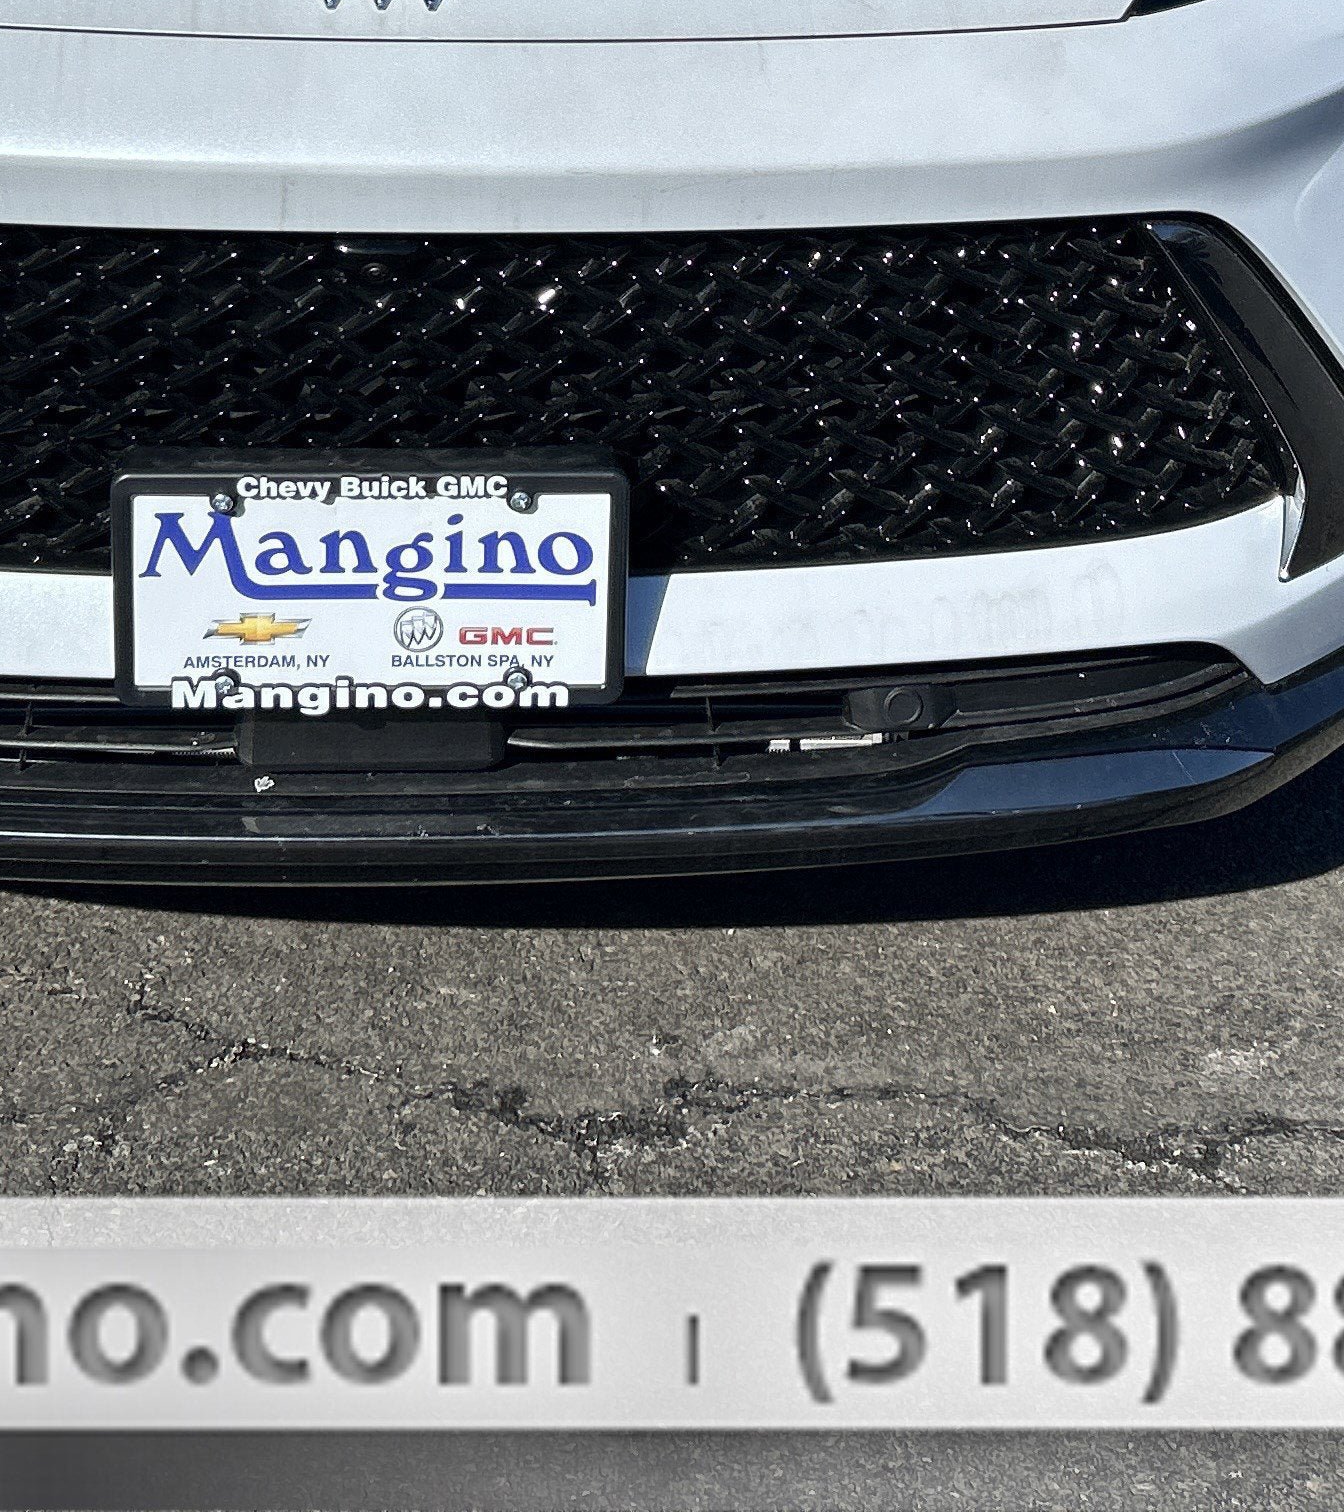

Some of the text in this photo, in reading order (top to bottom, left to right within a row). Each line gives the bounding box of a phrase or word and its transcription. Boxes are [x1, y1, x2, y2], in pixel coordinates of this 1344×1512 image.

[236, 475, 508, 501] Chevy Buick GMC
[138, 510, 597, 607] Mangino
[459, 626, 555, 646] GMC
[183, 654, 331, 671] AMSTERDAM, NY
[391, 654, 483, 669] BALLSTON
[530, 654, 555, 669] NY
[171, 676, 569, 716] Mangino.com
